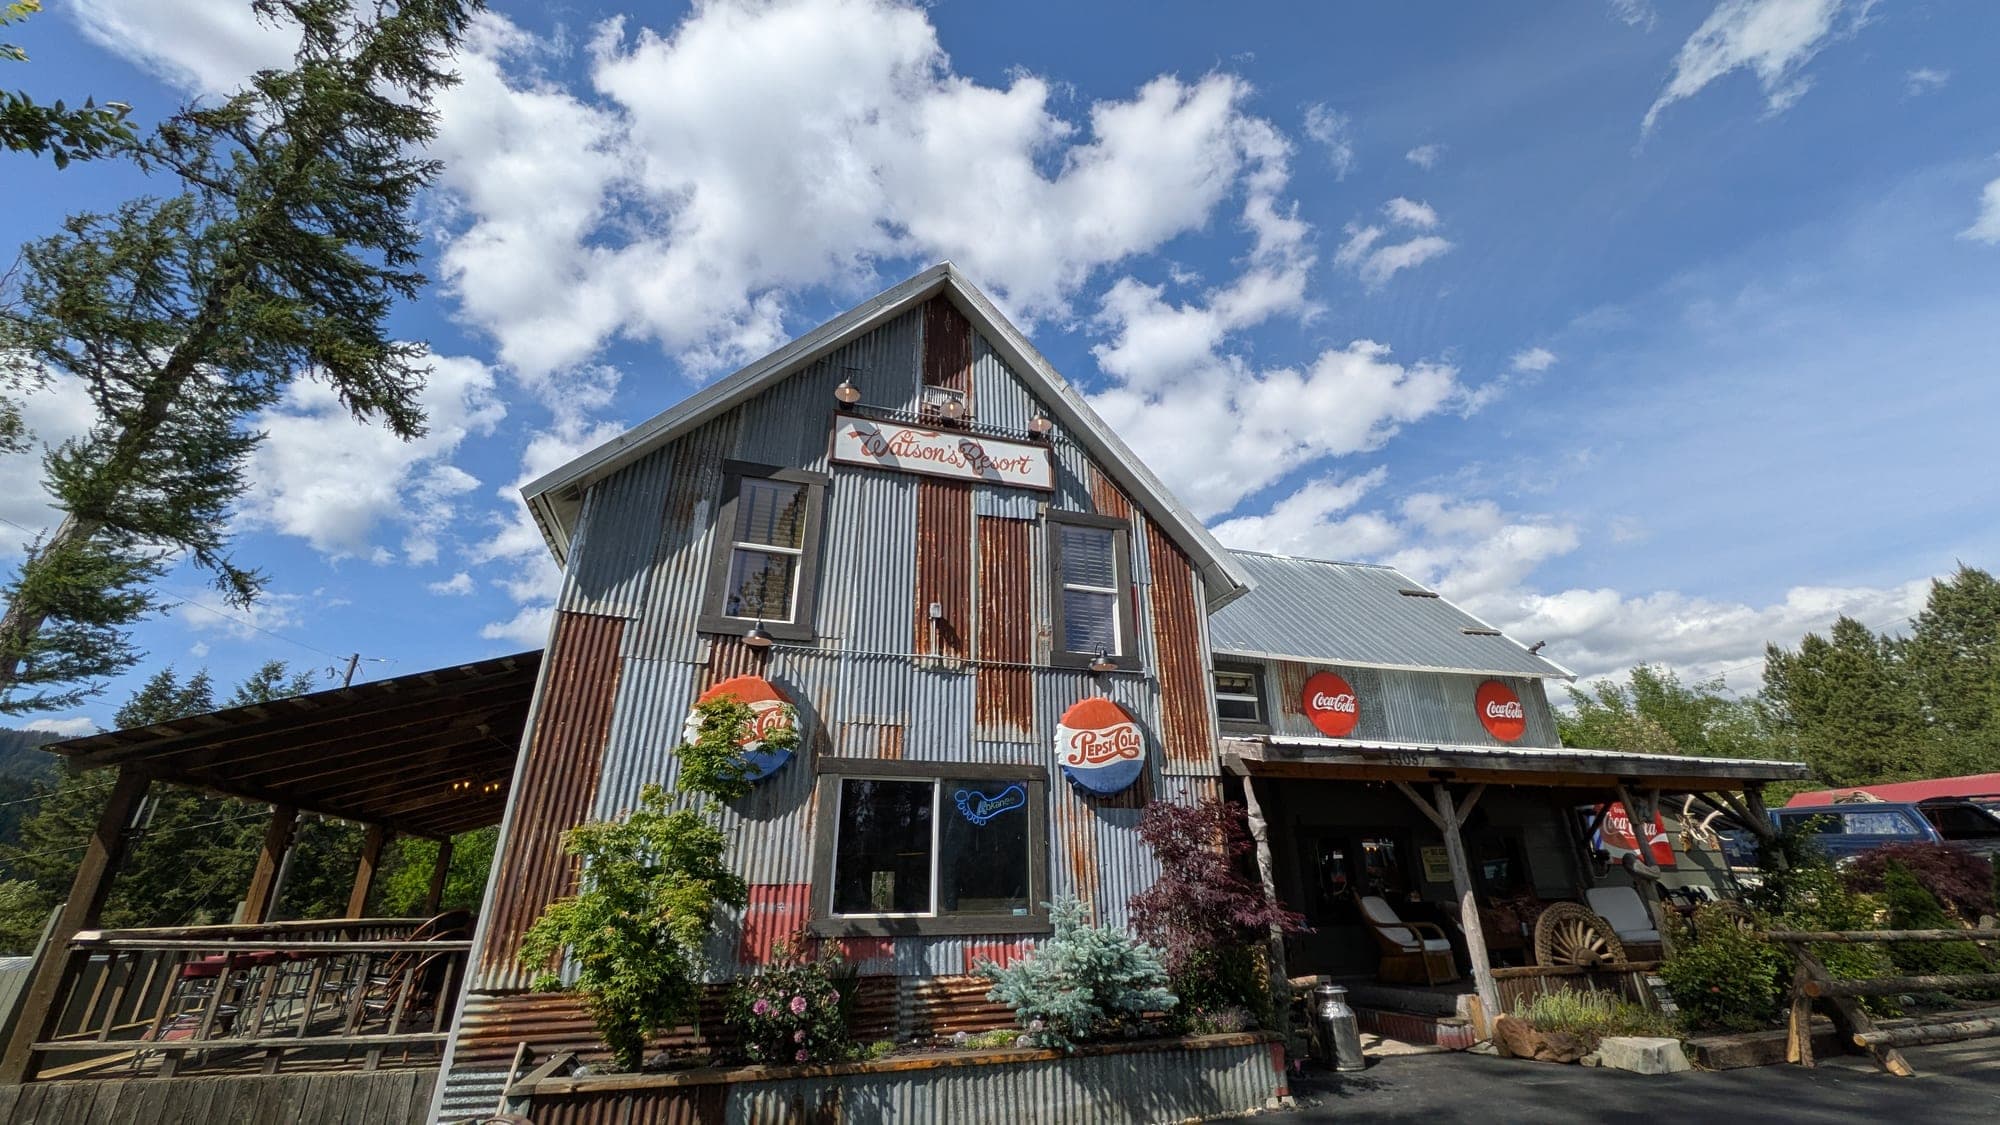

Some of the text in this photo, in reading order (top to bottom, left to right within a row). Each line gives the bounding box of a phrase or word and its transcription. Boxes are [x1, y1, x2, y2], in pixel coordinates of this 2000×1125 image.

[847, 429, 1032, 476] Watson's Resort
[1312, 691, 1355, 713] Coca-Cola
[1486, 700, 1524, 719] Coca-Cola
